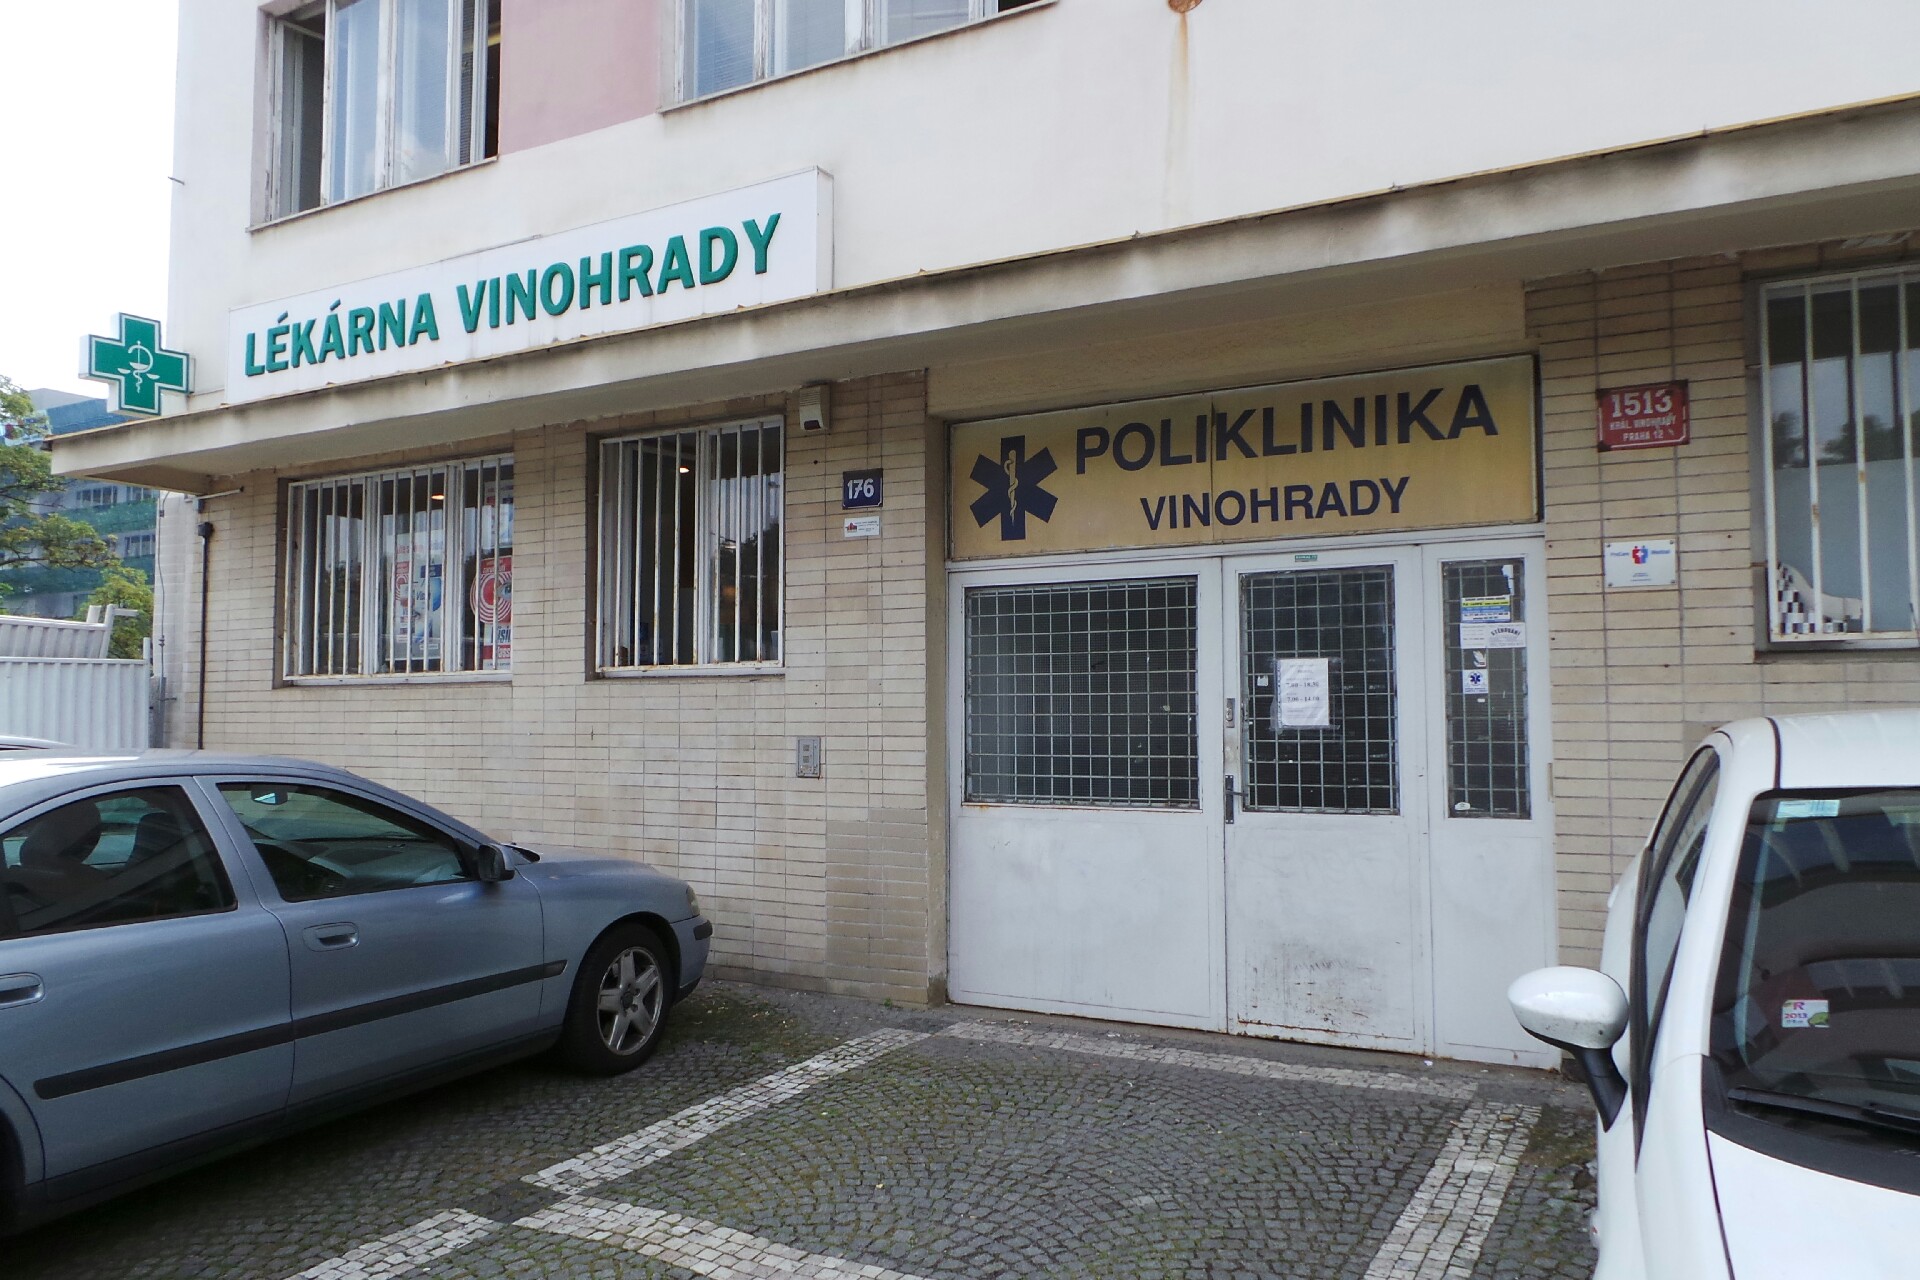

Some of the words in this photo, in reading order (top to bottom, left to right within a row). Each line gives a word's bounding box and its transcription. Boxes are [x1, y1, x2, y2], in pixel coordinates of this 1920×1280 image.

[245, 293, 439, 376] LÉKÁRNA
[456, 212, 781, 333] VINOHRADY
[1611, 389, 1673, 417] 1513
[1076, 384, 1498, 475] POLIKLINIKA
[1623, 432, 1650, 441] PRAHA
[1653, 429, 1664, 439] 12
[847, 478, 875, 499] 176
[1140, 476, 1410, 531] VINOHRADY
